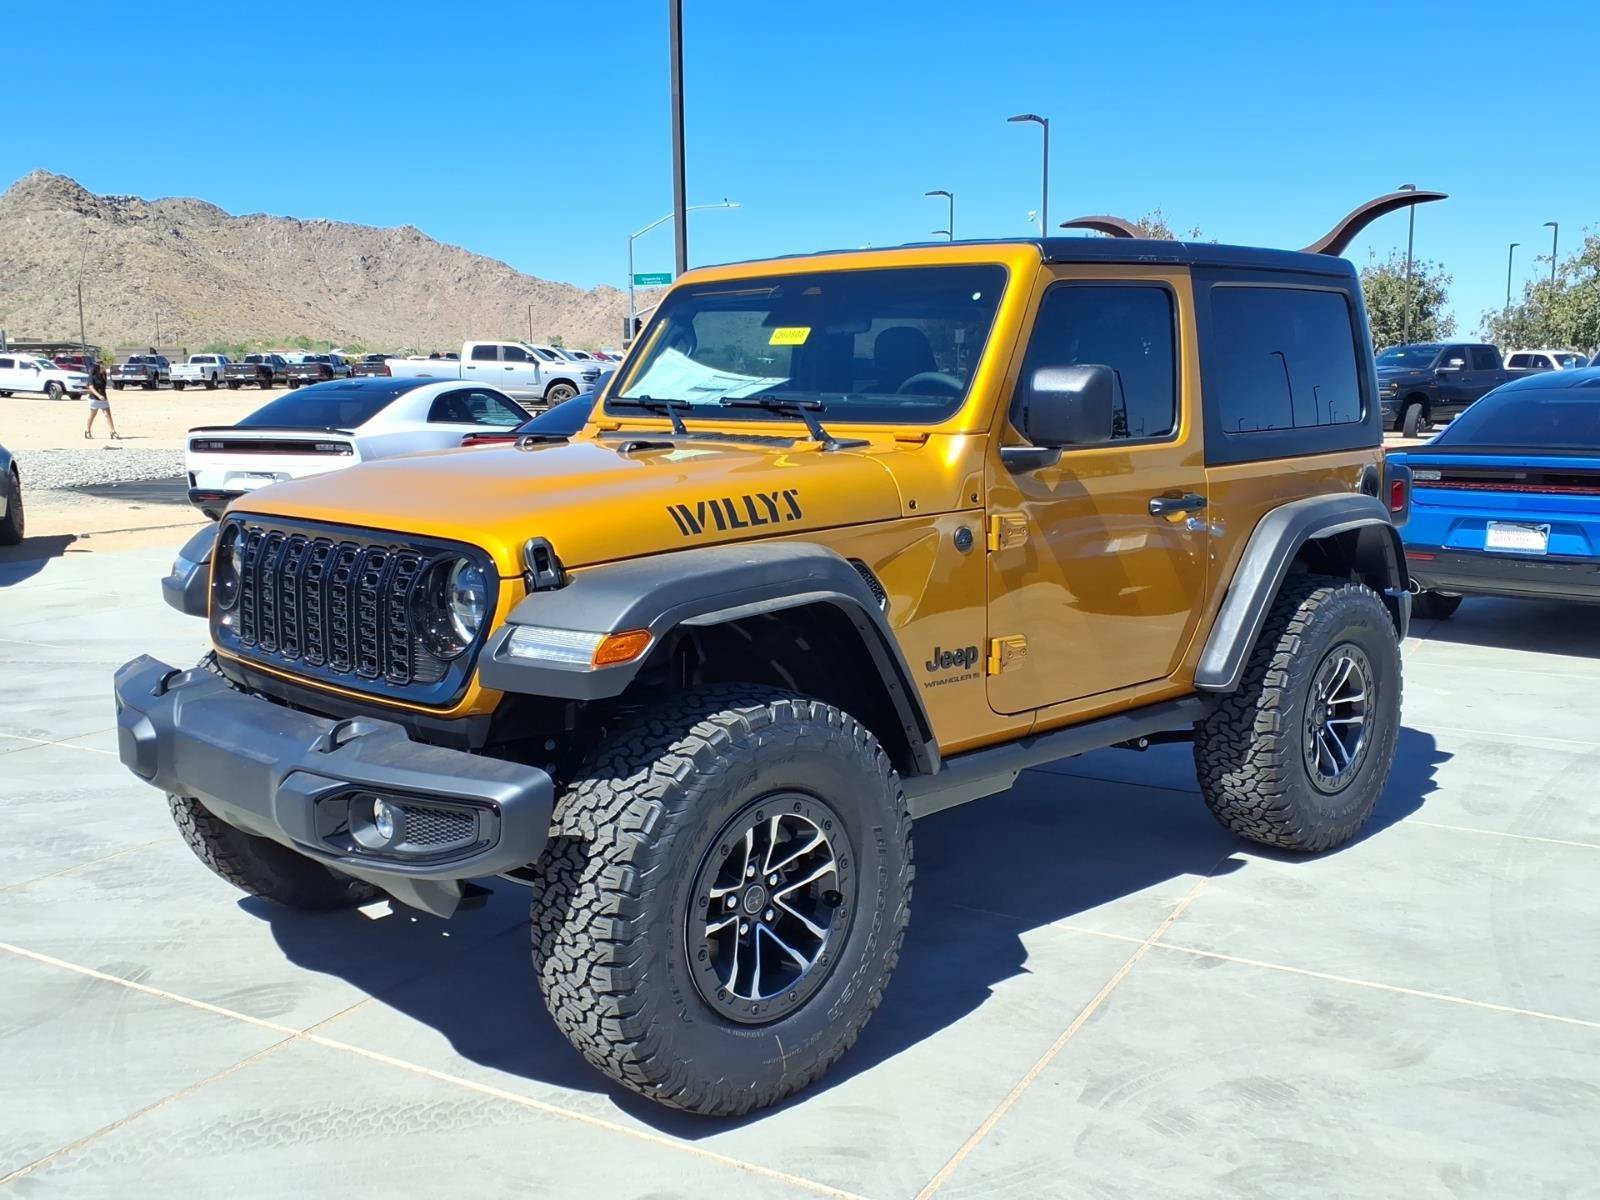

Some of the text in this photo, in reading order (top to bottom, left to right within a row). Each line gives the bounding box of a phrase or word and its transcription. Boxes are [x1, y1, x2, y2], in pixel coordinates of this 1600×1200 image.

[666, 489, 802, 536] WILLYS
[926, 646, 978, 672] Jeep
[925, 674, 972, 688] WRANGLER
